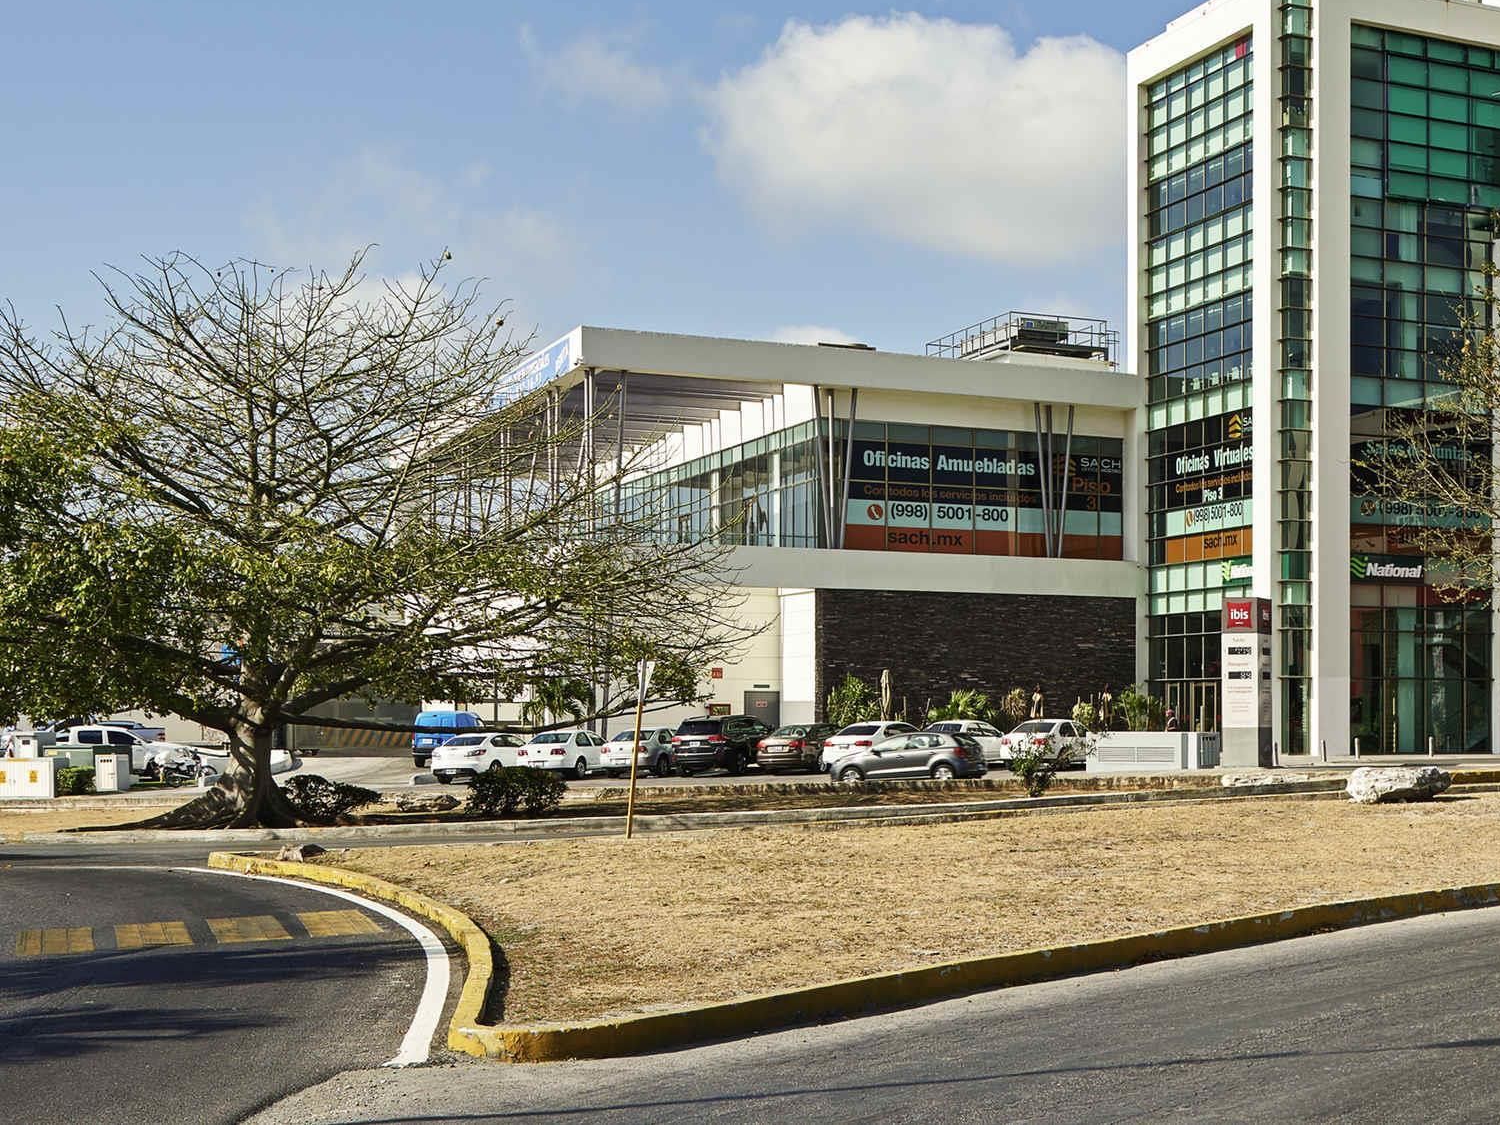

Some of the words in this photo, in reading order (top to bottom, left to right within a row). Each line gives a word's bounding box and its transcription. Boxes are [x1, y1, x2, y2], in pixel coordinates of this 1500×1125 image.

[863, 450, 930, 470] Oficinas
[936, 455, 1036, 475] Amuebladas
[1080, 457, 1121, 469] SACH
[1175, 454, 1210, 475] Oficinas
[1213, 445, 1253, 468] Virtuales
[888, 487, 920, 498] todos
[1072, 477, 1112, 494] Piso
[1087, 495, 1098, 511] 3
[891, 503, 928, 521] (998)
[937, 506, 1009, 522] 5001-800
[888, 531, 963, 547] sach.mx
[1366, 562, 1422, 578] National
[1230, 608, 1249, 620] ibis
